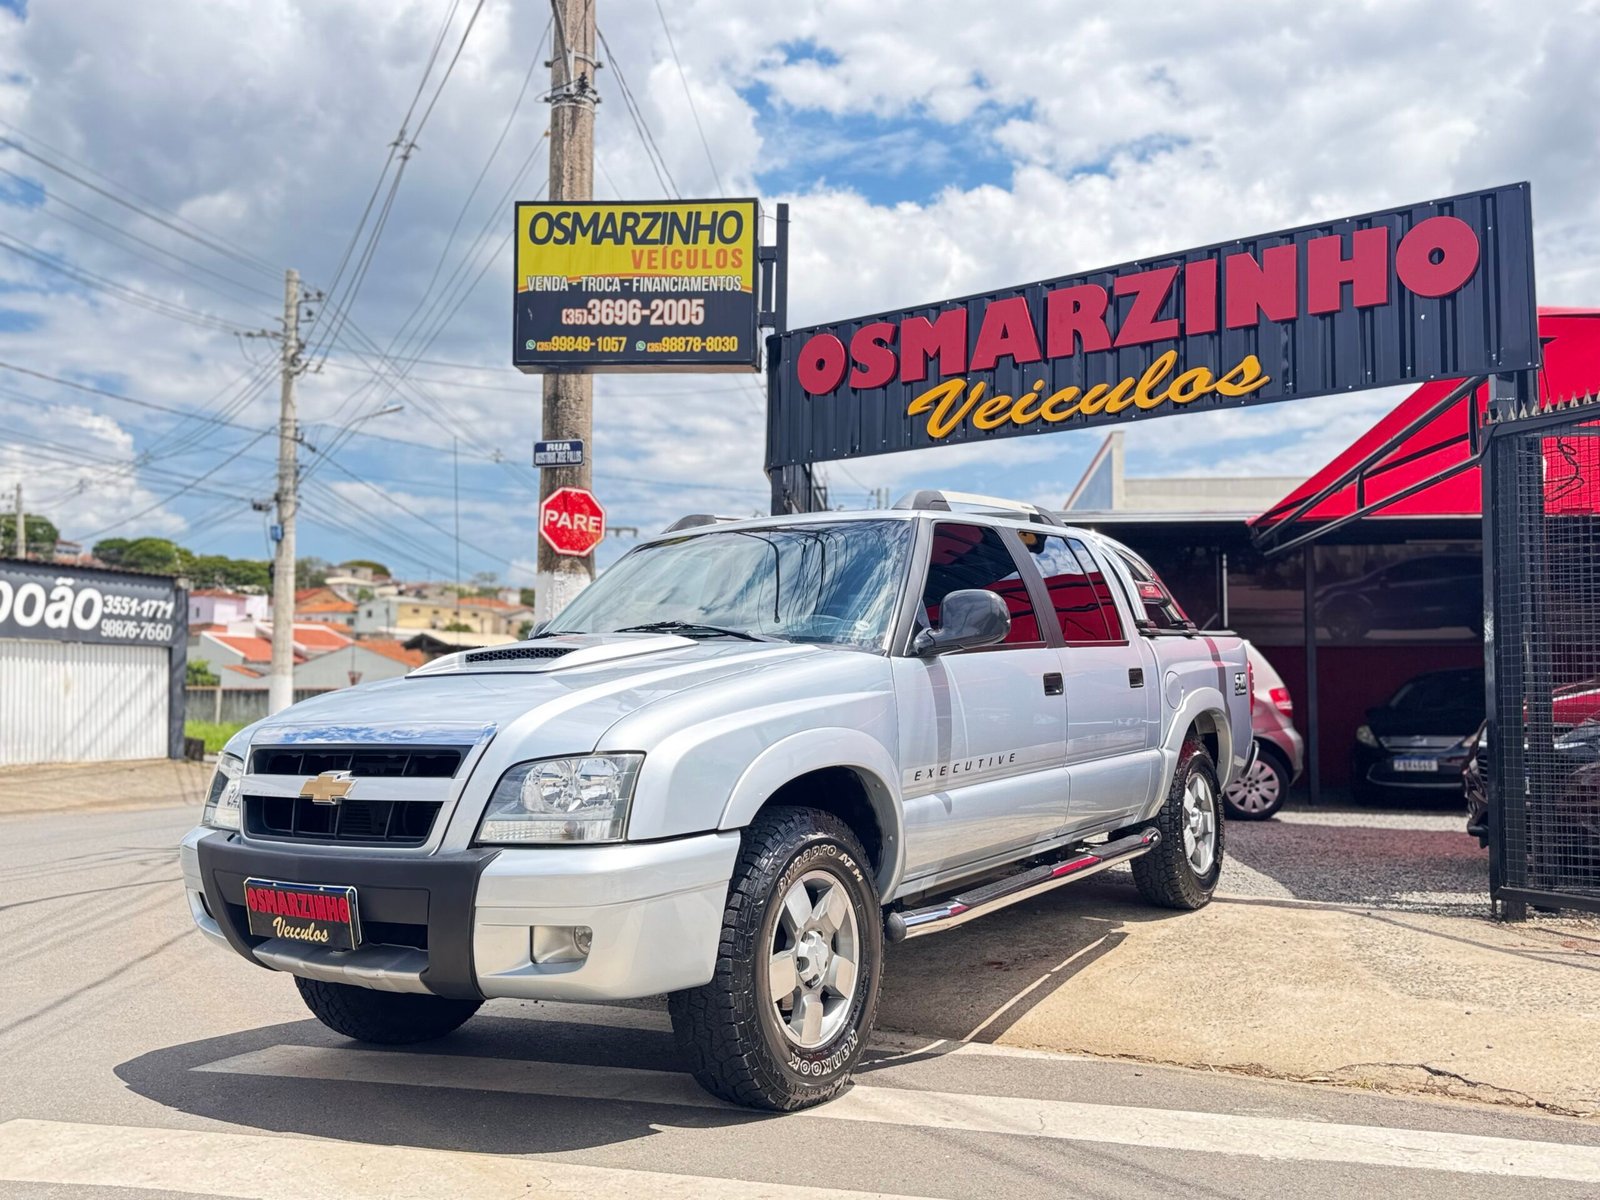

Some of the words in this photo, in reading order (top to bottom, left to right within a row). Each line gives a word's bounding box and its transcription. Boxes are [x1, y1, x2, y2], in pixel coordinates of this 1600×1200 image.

[529, 210, 743, 246] OSMARZINHO
[631, 245, 743, 270] VEÍCULOS
[527, 276, 569, 292] VENDA
[581, 277, 621, 292] TROCA
[633, 276, 742, 292] FINANCIAMENTOS
[797, 215, 1480, 395] OSMARZINHO
[908, 349, 1269, 438] Veiculos
[546, 443, 571, 452] RUA
[544, 509, 601, 533] PARE
[914, 753, 1015, 781] EXECUTIVE
[247, 887, 350, 923] OSMARZINHO
